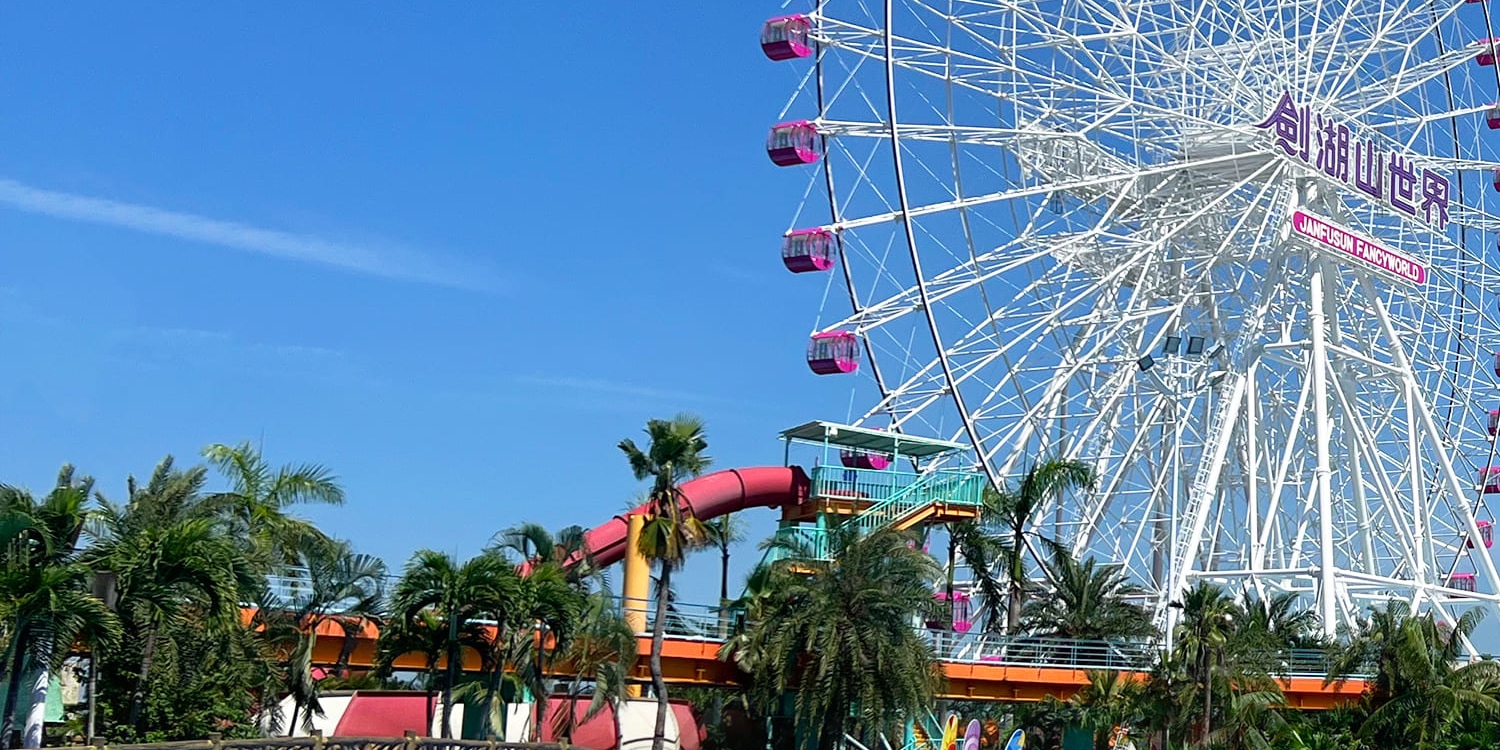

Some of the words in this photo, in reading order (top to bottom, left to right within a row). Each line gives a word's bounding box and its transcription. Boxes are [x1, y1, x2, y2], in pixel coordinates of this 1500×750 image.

[1255, 91, 1449, 230] 劍湖山世界
[1299, 218, 1354, 252] JANFUSUN
[1356, 240, 1419, 280] FANCYWORLD
